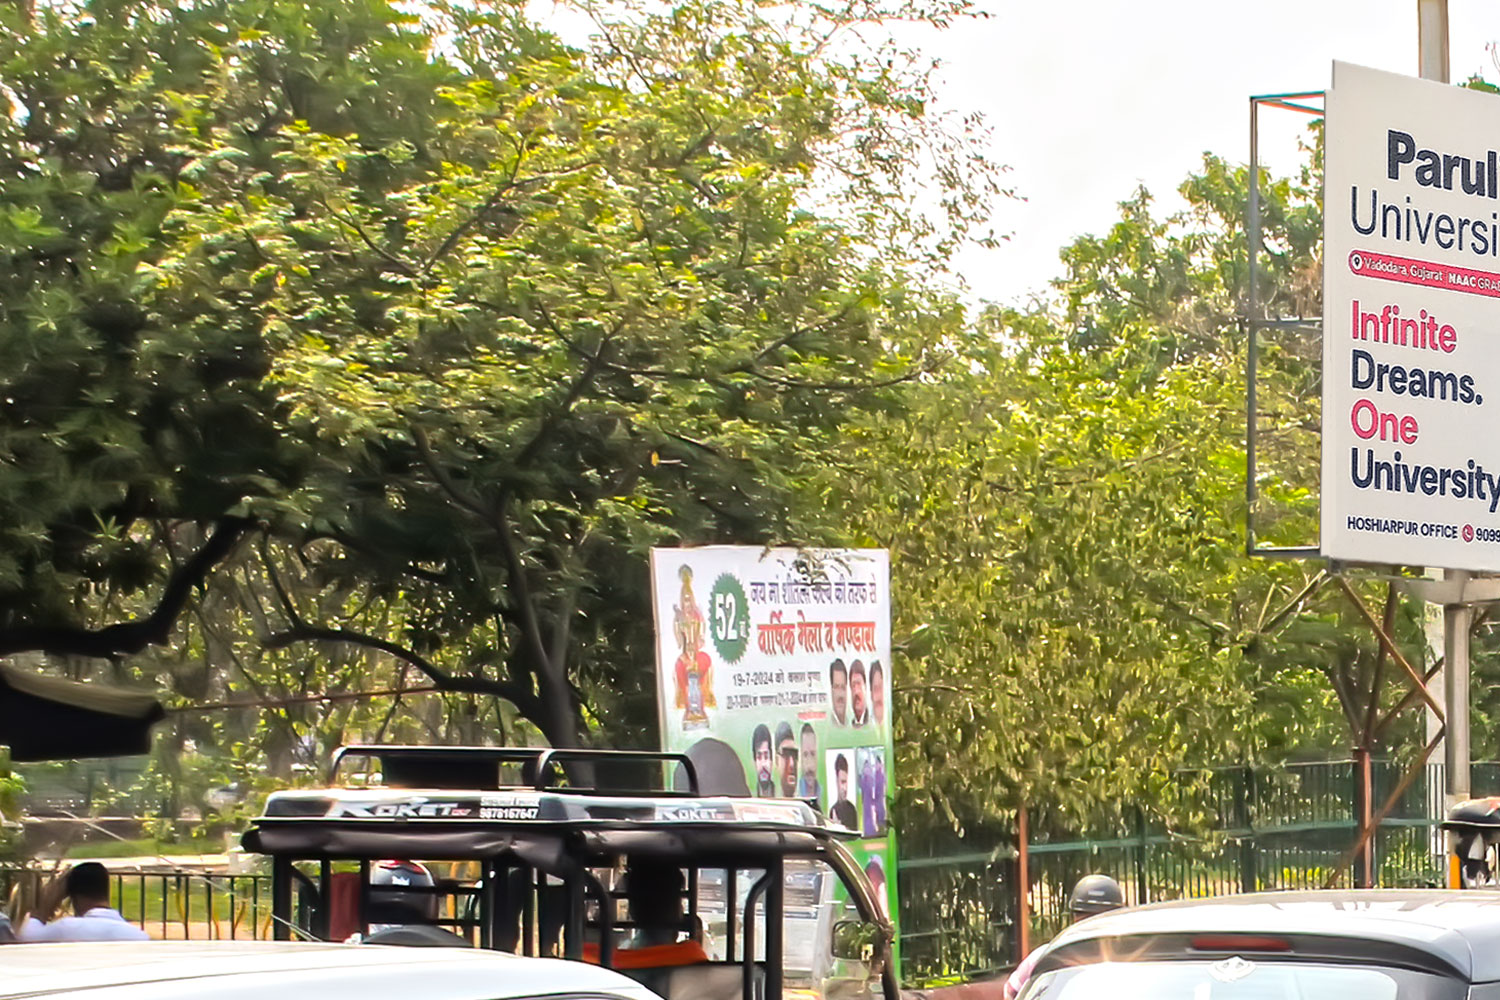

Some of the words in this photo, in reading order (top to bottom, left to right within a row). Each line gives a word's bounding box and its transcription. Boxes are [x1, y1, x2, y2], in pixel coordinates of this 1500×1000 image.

[1364, 257, 1409, 276] Vadodara,
[1410, 264, 1444, 282] Gujarat
[1449, 273, 1477, 288] NAAC
[1352, 300, 1457, 354] Infinite
[1352, 349, 1484, 405] Dreams.
[1351, 399, 1419, 445] One
[1347, 516, 1418, 537] HOSHIARPUR
[1420, 523, 1458, 540] OFFICE
[715, 592, 738, 641] 52
